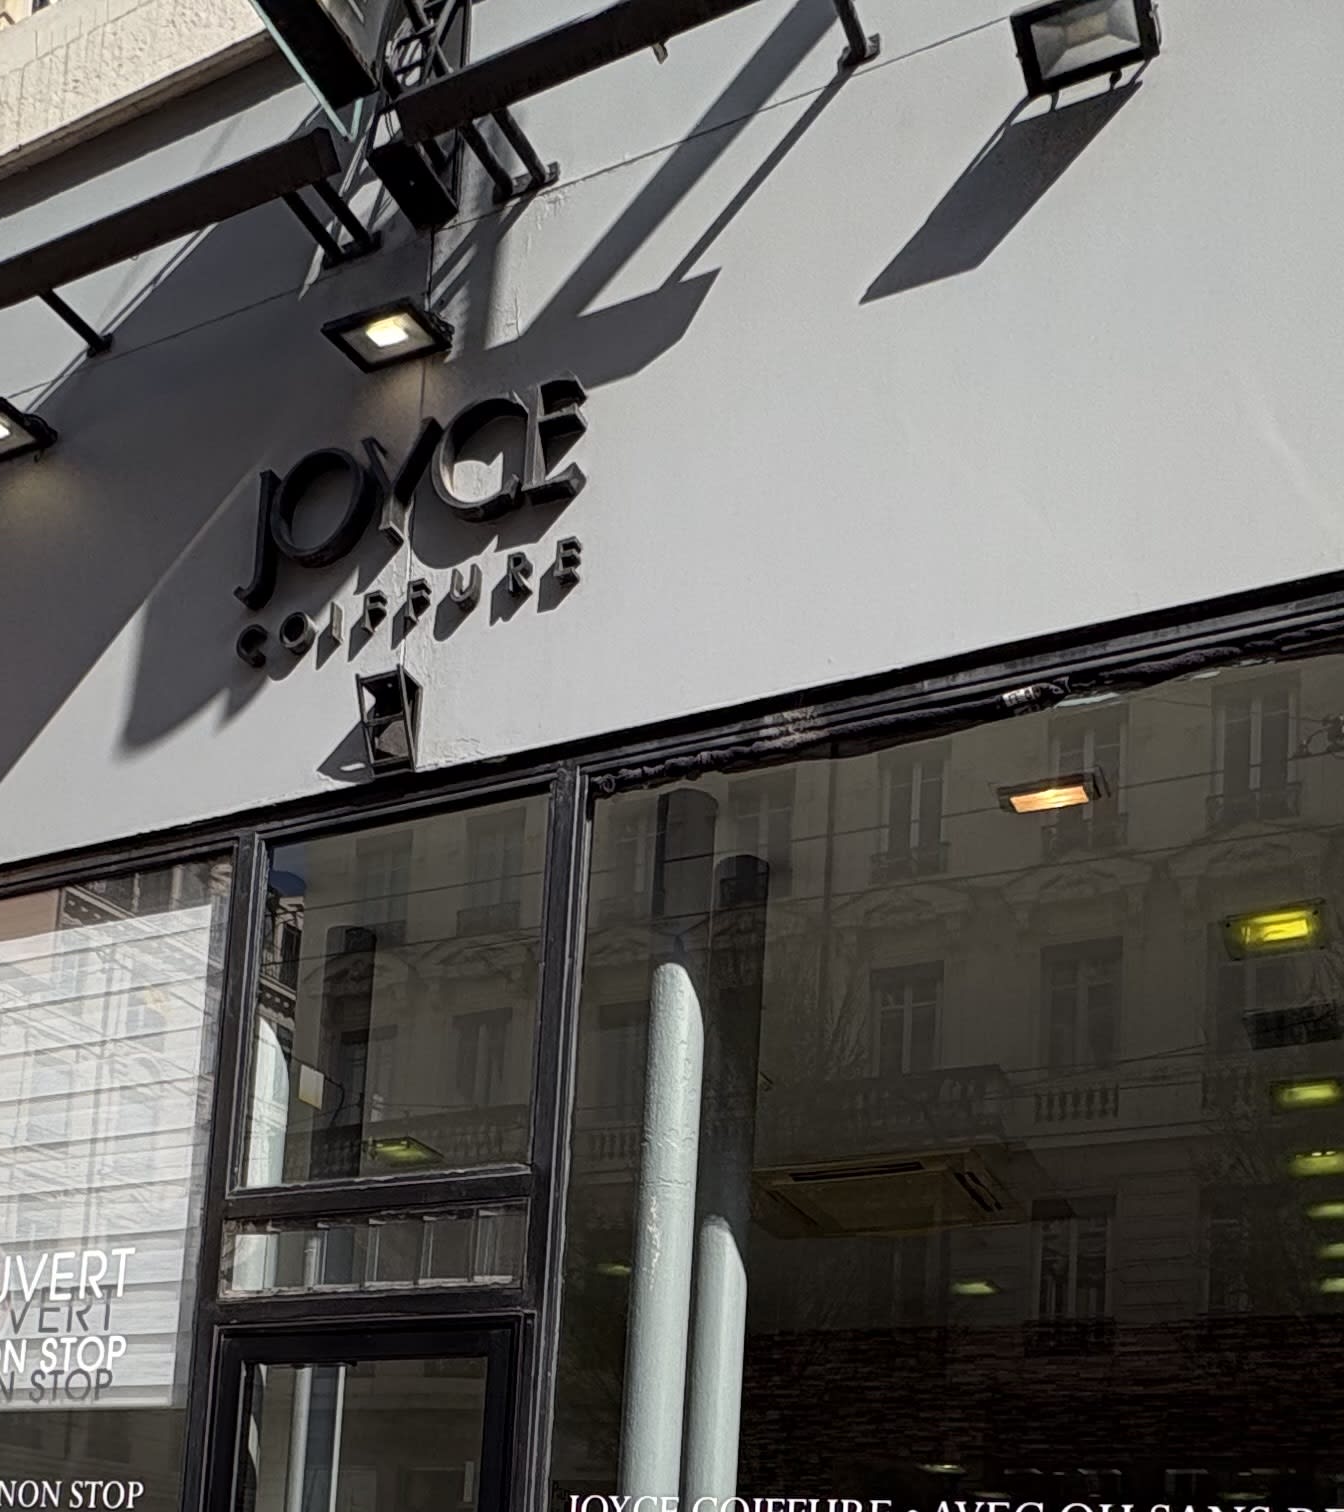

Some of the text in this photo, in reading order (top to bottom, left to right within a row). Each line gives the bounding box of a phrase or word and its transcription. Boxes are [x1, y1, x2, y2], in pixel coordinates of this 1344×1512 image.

[234, 373, 587, 610] JOYCE
[236, 536, 583, 668] COIFFURE
[39, 1335, 128, 1374] STOP
[69, 1480, 145, 1511] STOP
